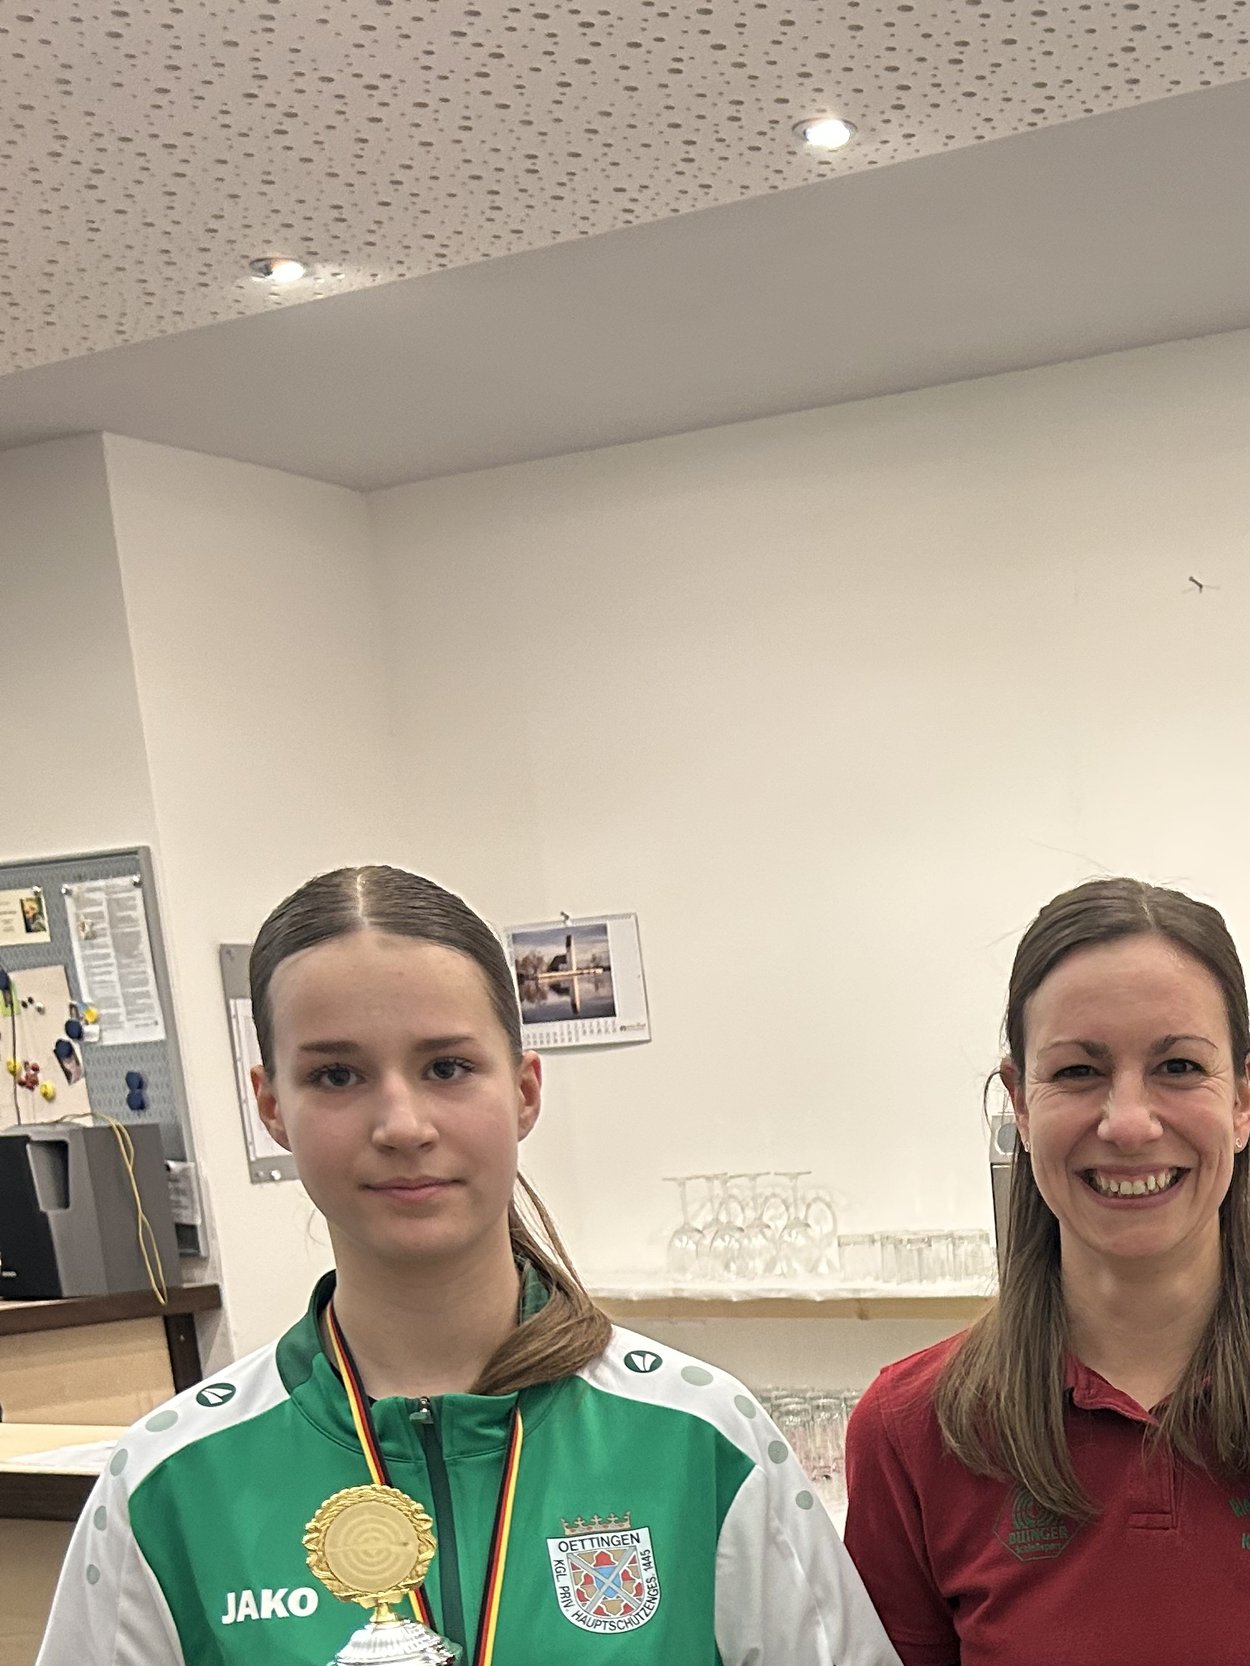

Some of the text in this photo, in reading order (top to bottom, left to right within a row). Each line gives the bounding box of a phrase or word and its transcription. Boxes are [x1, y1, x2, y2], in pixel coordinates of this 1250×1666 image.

[558, 1532, 640, 1553] OETTINGEN
[558, 1586, 575, 1612] PRIV.
[640, 1549, 652, 1574] 1445
[221, 1586, 319, 1625] JAKO
